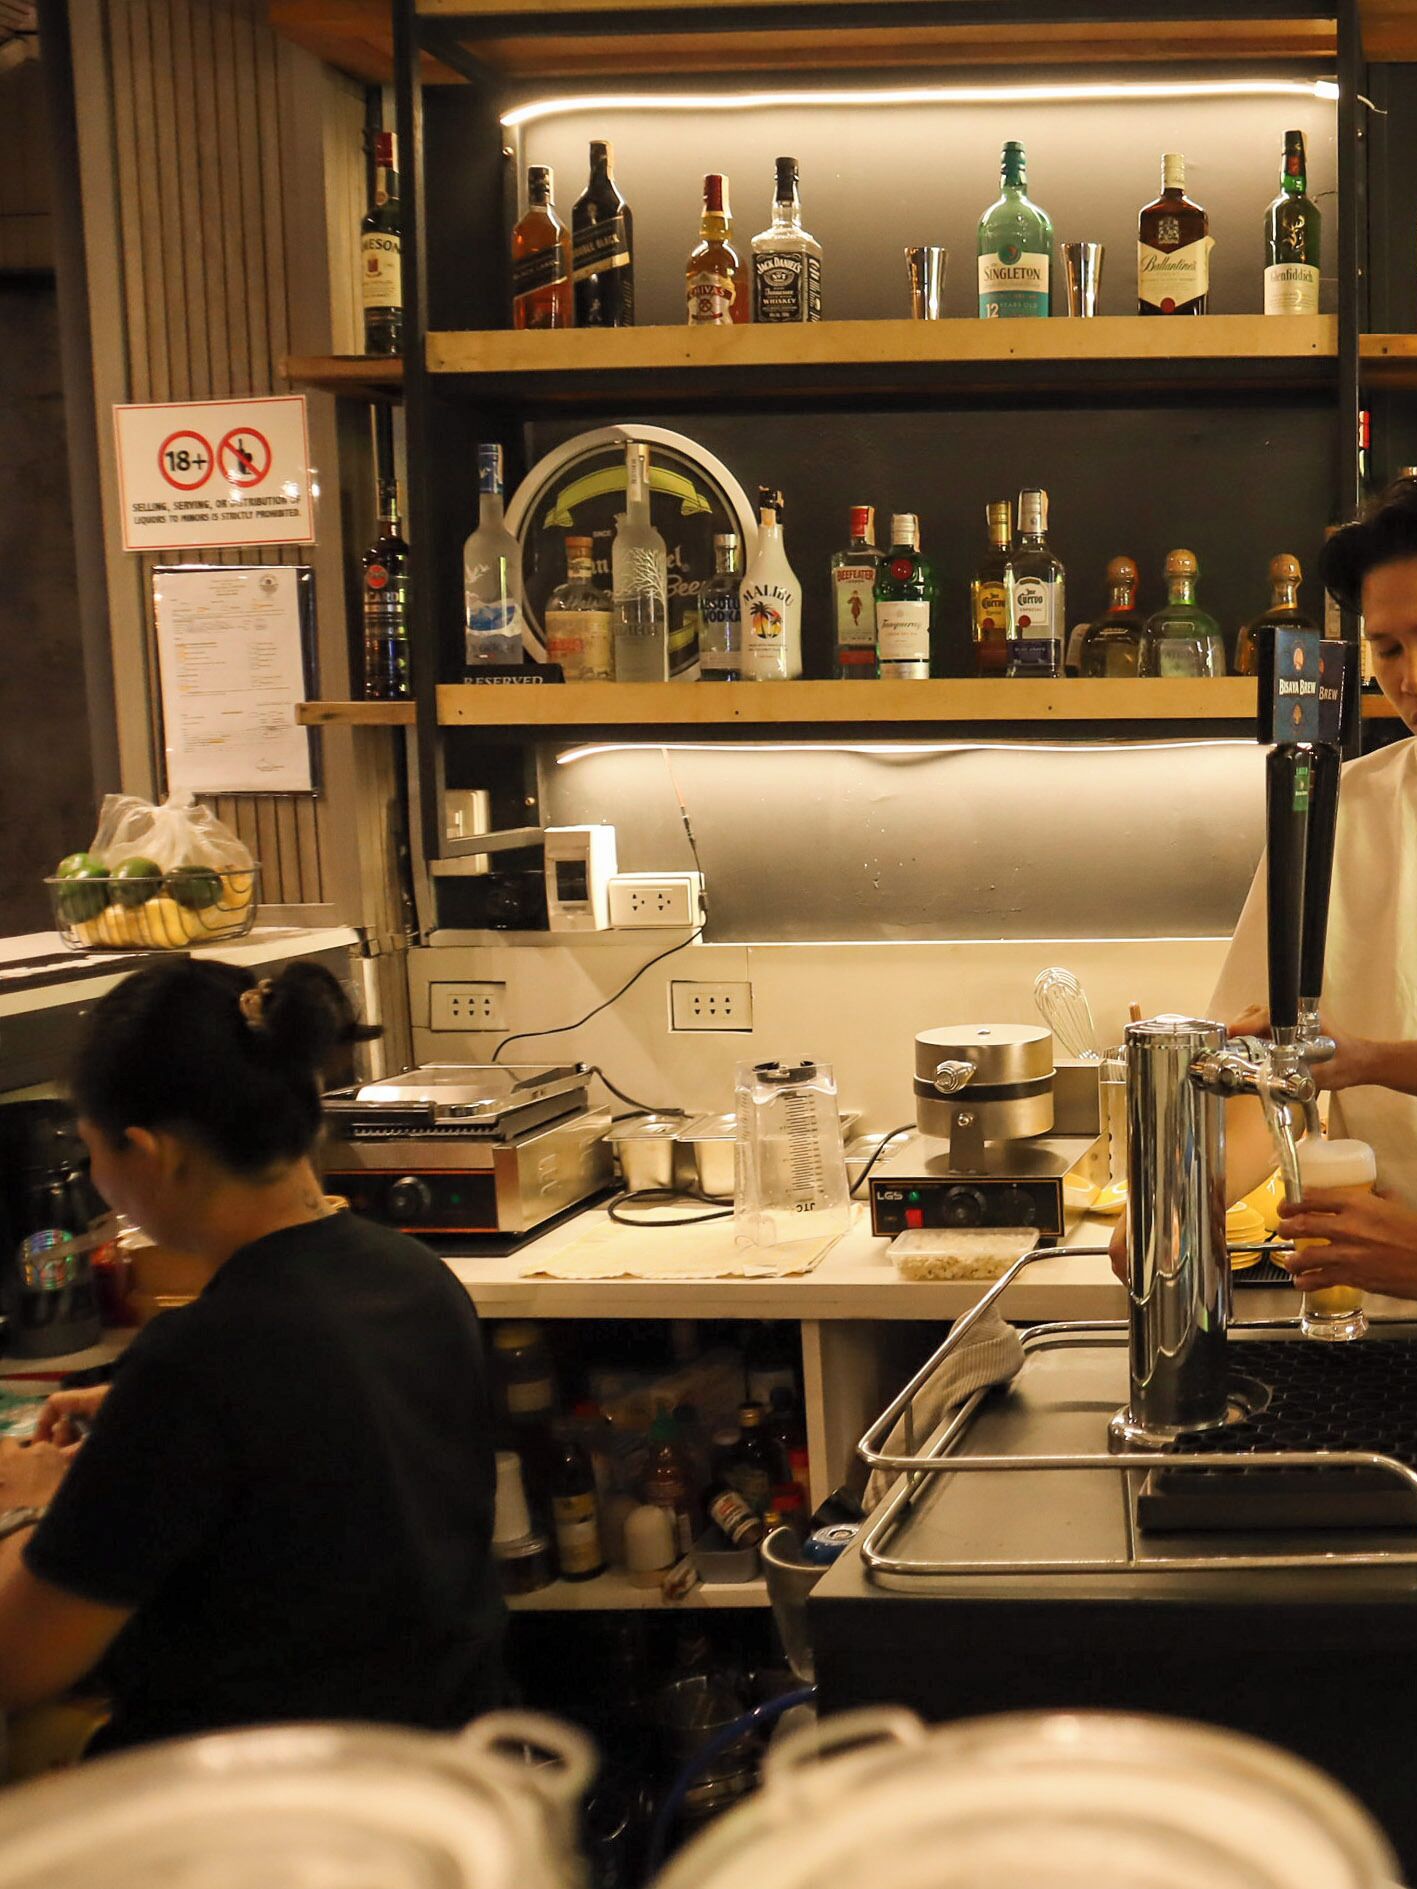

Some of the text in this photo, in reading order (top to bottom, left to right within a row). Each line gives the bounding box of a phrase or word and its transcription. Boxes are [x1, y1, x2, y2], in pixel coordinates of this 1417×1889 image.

[984, 267, 1041, 281] SINGLETON
[985, 303, 999, 318] 12
[165, 450, 208, 472] 18+
[837, 569, 874, 582] BEEFEATER
[742, 584, 793, 607] MALIBU
[1279, 678, 1317, 695] BISAYA BREW
[1318, 686, 1338, 700] BREW
[795, 1202, 816, 1213] JTC
